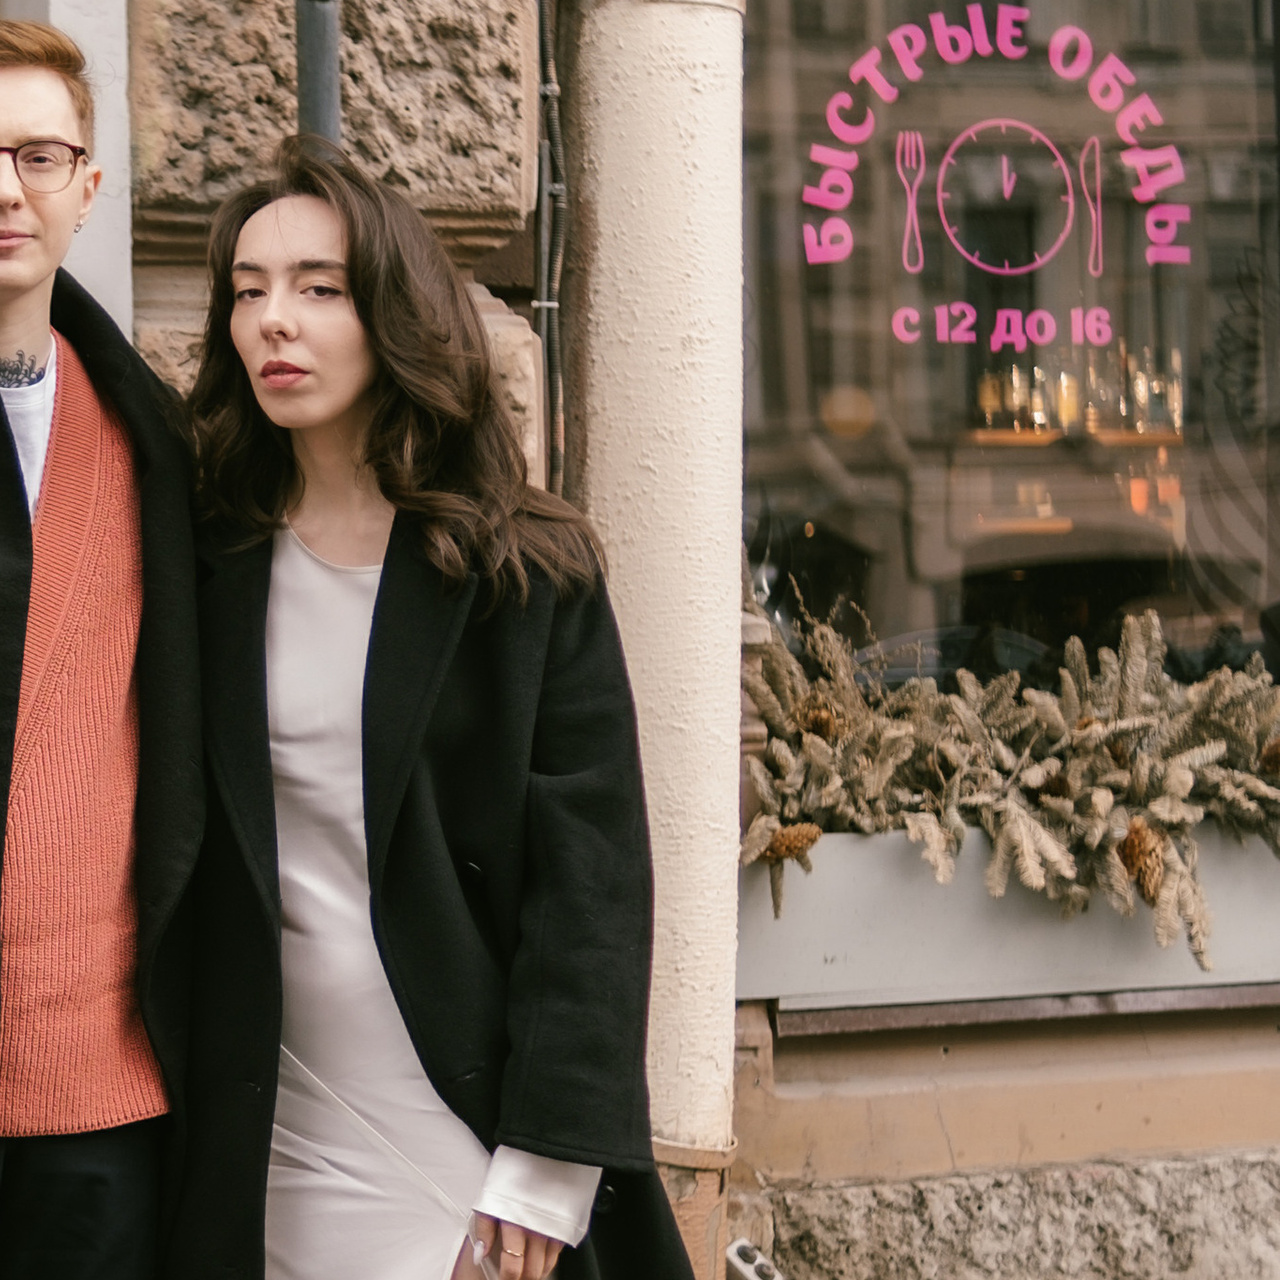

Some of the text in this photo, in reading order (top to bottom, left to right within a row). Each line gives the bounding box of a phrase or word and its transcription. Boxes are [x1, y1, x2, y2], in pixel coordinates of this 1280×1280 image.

[803, 3, 1191, 265] БЫСТРЫЕ ОБЕДЫ
[934, 301, 977, 344] 12
[1071, 306, 1113, 346] 16
